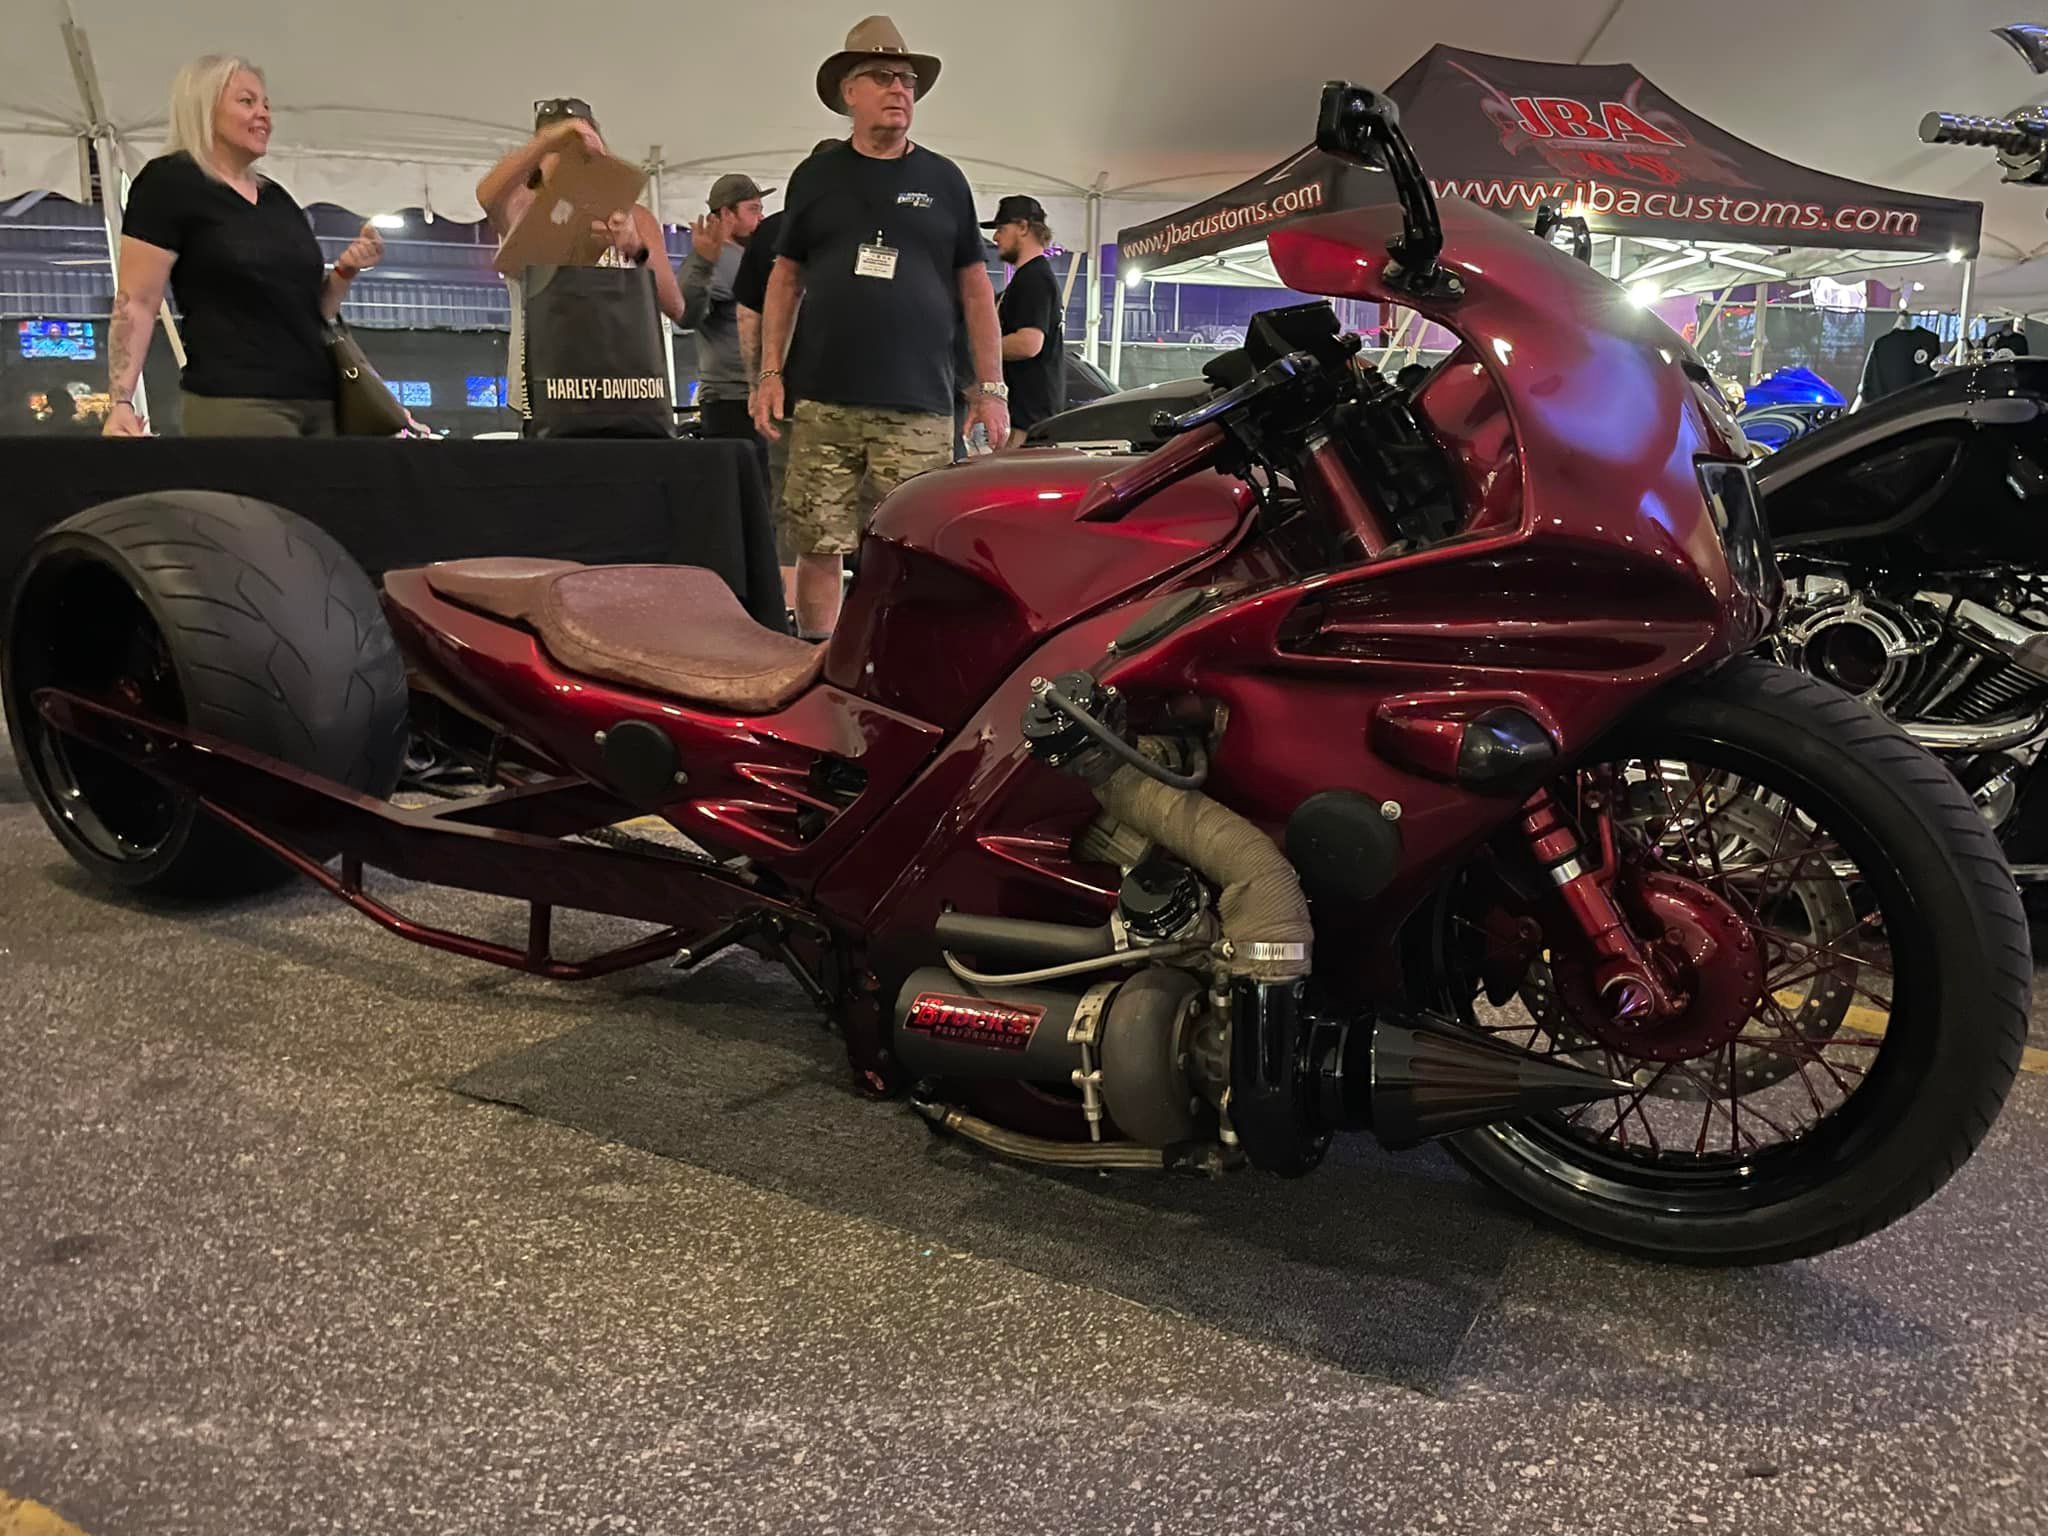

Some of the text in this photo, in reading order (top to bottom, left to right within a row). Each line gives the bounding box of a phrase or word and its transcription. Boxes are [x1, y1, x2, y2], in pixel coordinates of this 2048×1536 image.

[1510, 97, 1686, 147] JBA
[1122, 183, 1321, 258] www.jbacustoms.com
[547, 377, 665, 399] HARLEY-DAVIDSON
[934, 1025, 1022, 1045] PERFORMANCE
